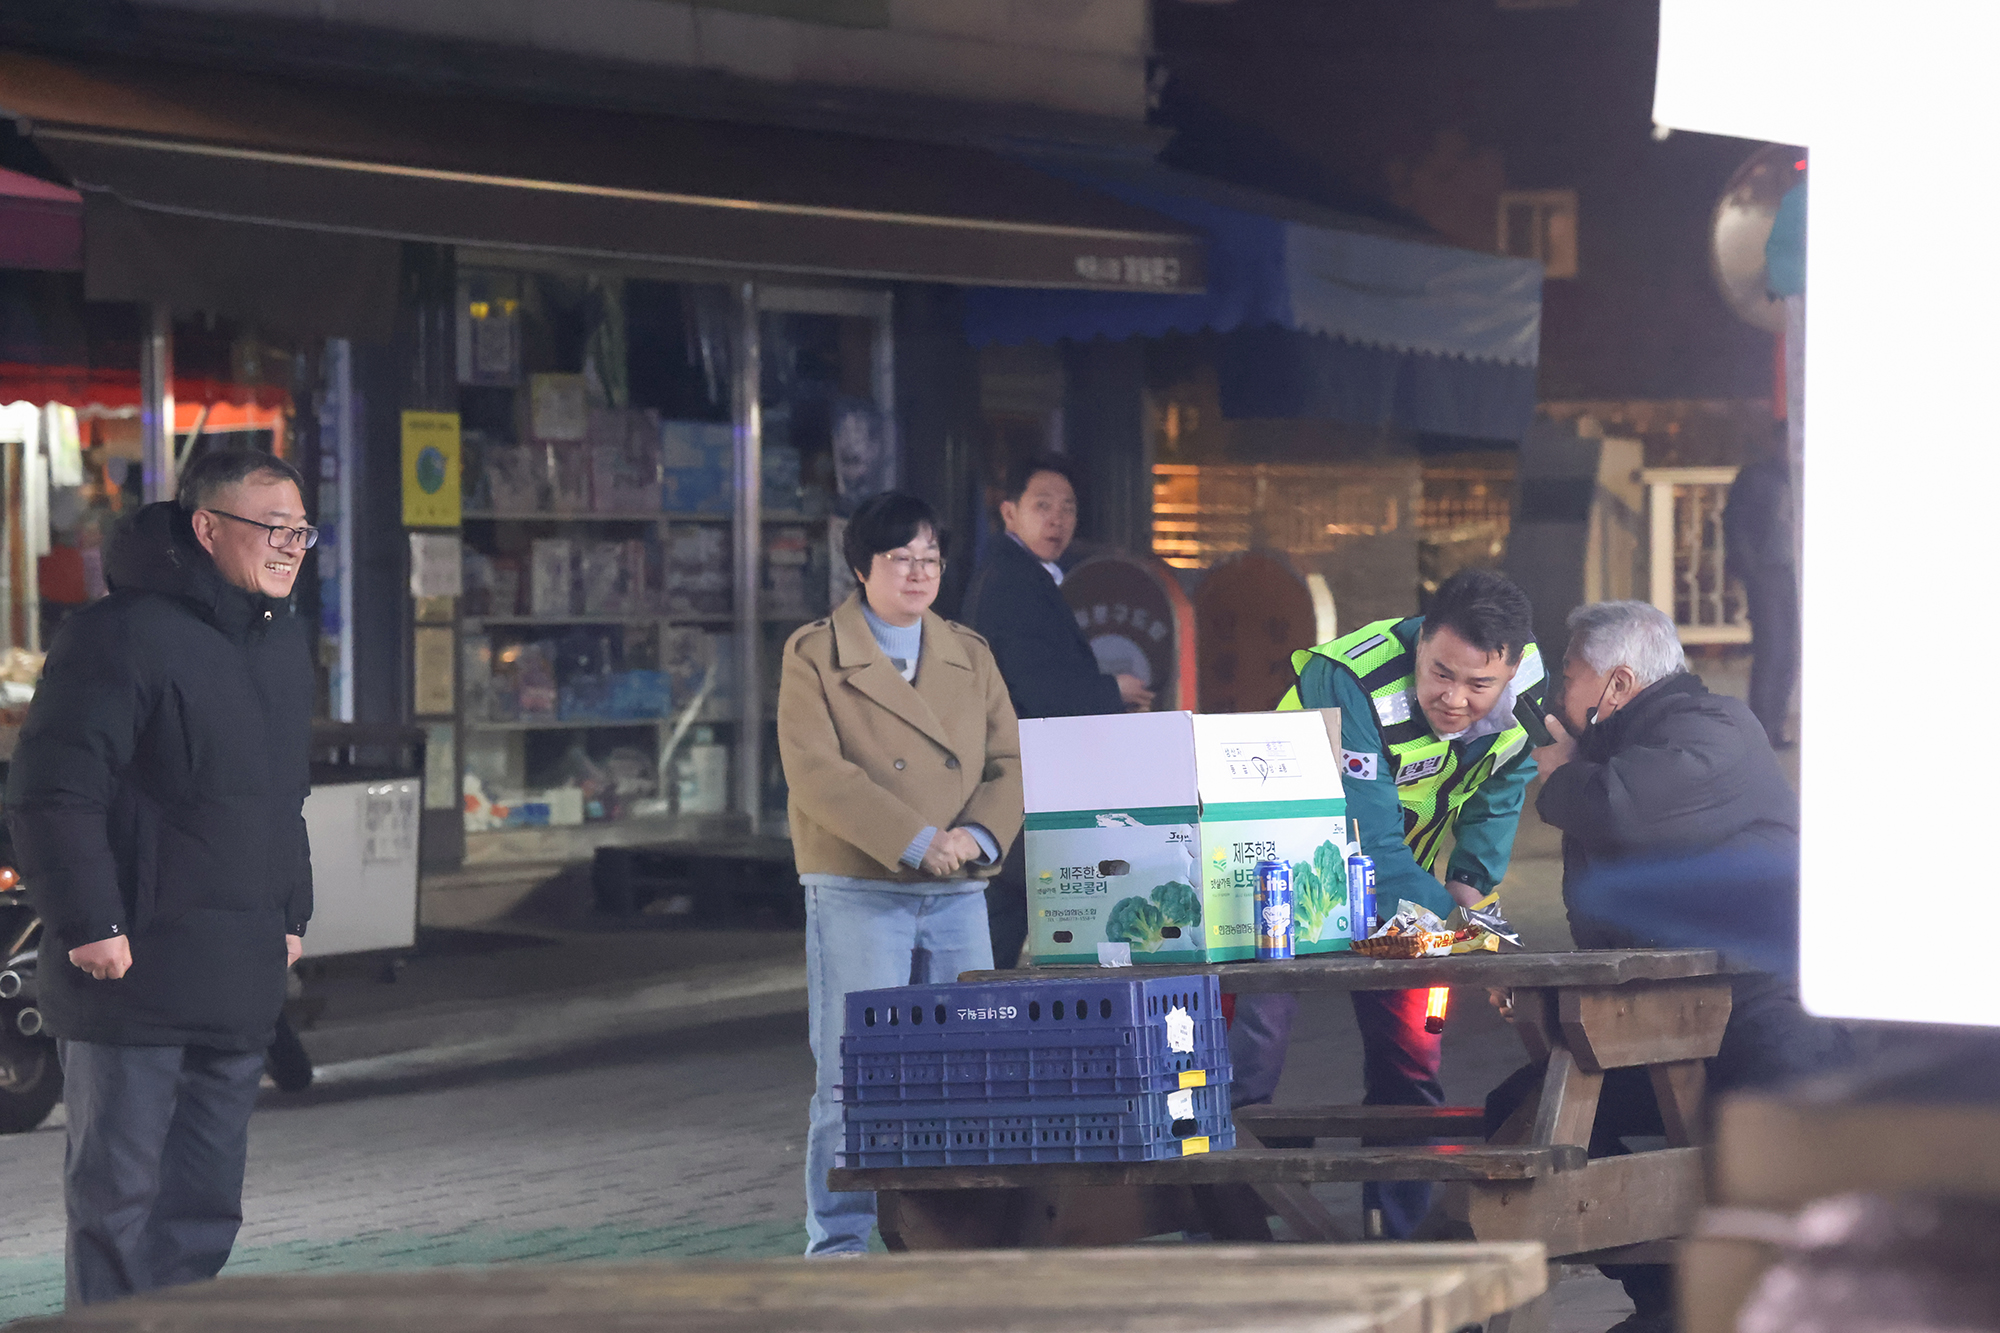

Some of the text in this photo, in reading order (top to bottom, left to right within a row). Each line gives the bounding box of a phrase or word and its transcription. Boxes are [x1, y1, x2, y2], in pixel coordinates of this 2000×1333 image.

[1169, 831, 1189, 842] Jeju
[1233, 841, 1276, 864] 제주한경
[1060, 881, 1107, 895] 브로콜리
